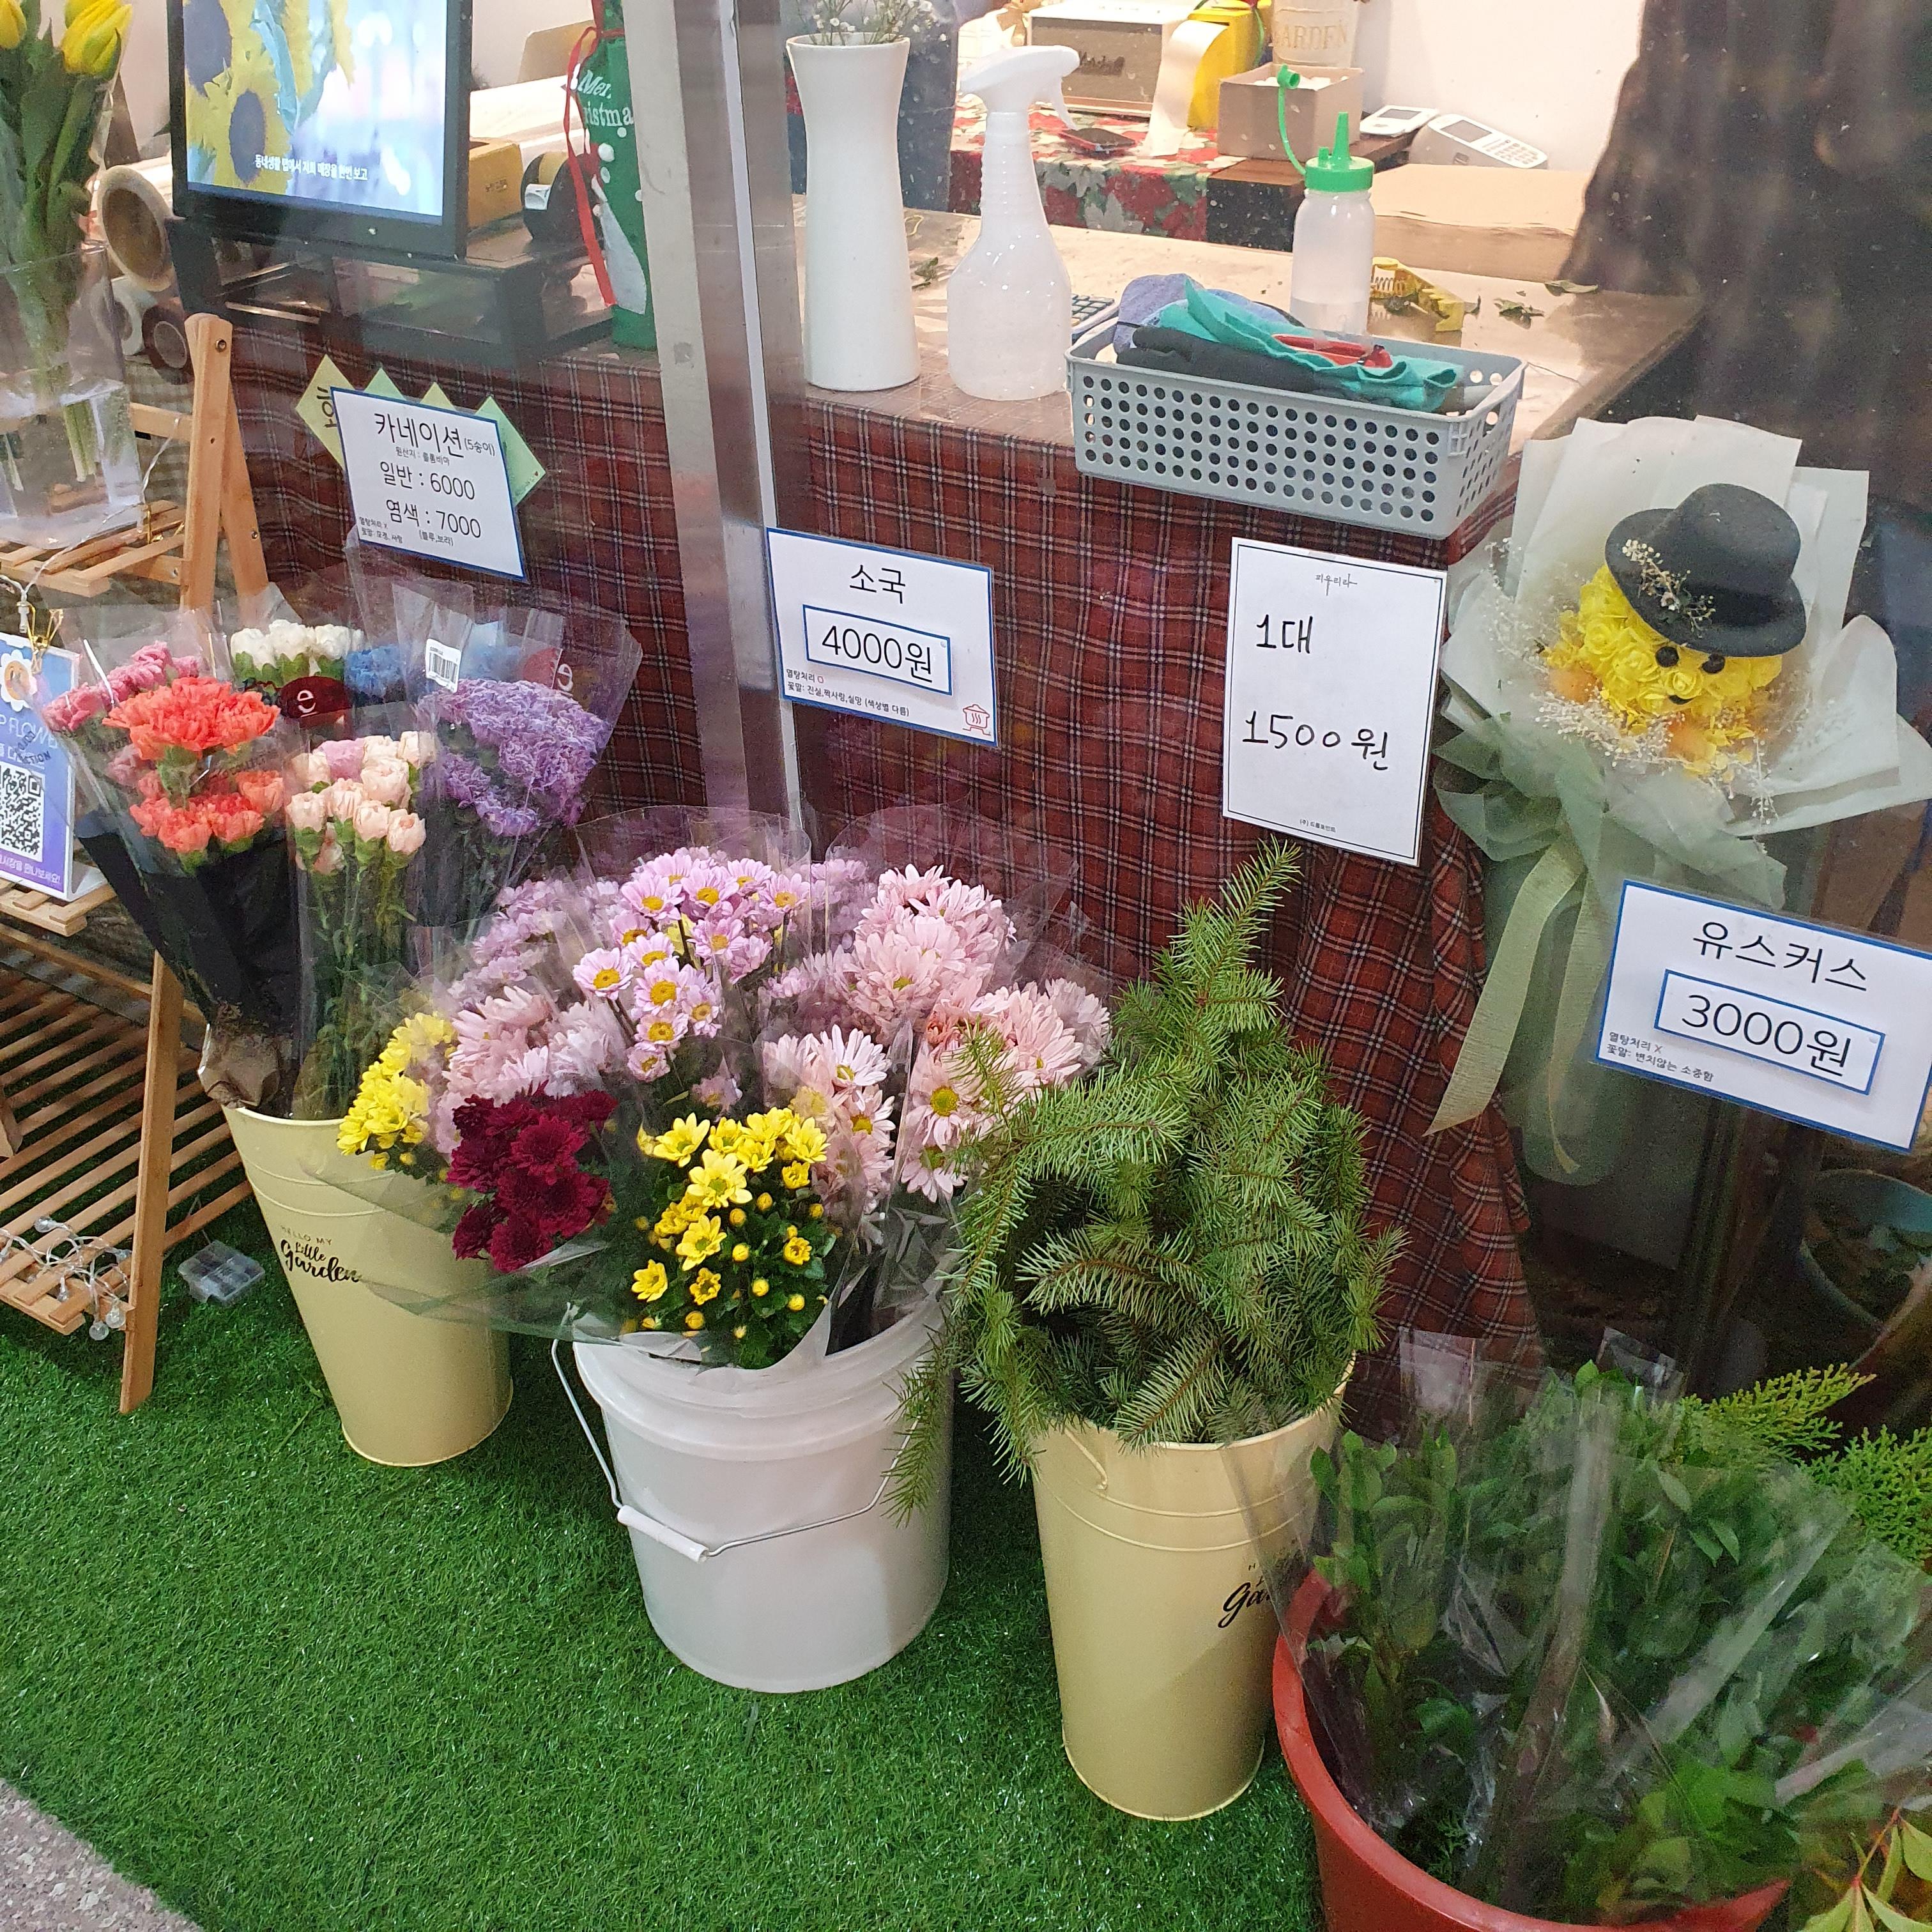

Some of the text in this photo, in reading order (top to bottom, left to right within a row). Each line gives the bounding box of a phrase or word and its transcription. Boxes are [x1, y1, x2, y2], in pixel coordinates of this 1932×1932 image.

[578, 70, 611, 99] Mer
[353, 167, 369, 181] 보고
[374, 413, 495, 458] 카네이션 (5송이)
[379, 461, 413, 490] 일반
[430, 472, 476, 500] 6000
[385, 499, 420, 527] 염색
[435, 510, 481, 538] 7000
[849, 564, 906, 604] 소국
[1315, 573, 1358, 596] 피우리라
[1255, 613, 1314, 654] 1대
[821, 624, 933, 683] 4000원
[786, 668, 815, 683] 열탕처리
[787, 681, 805, 693] 꽃말:
[892, 705, 910, 717] 다름)
[1692, 921, 1867, 992] 유스커스
[1609, 1031, 1651, 1052] 열탕처리
[1681, 993, 1851, 1077] 3000원
[1607, 1043, 1714, 1082] 꽃말: 변치않는 소중함
[316, 1237, 332, 1246] MY
